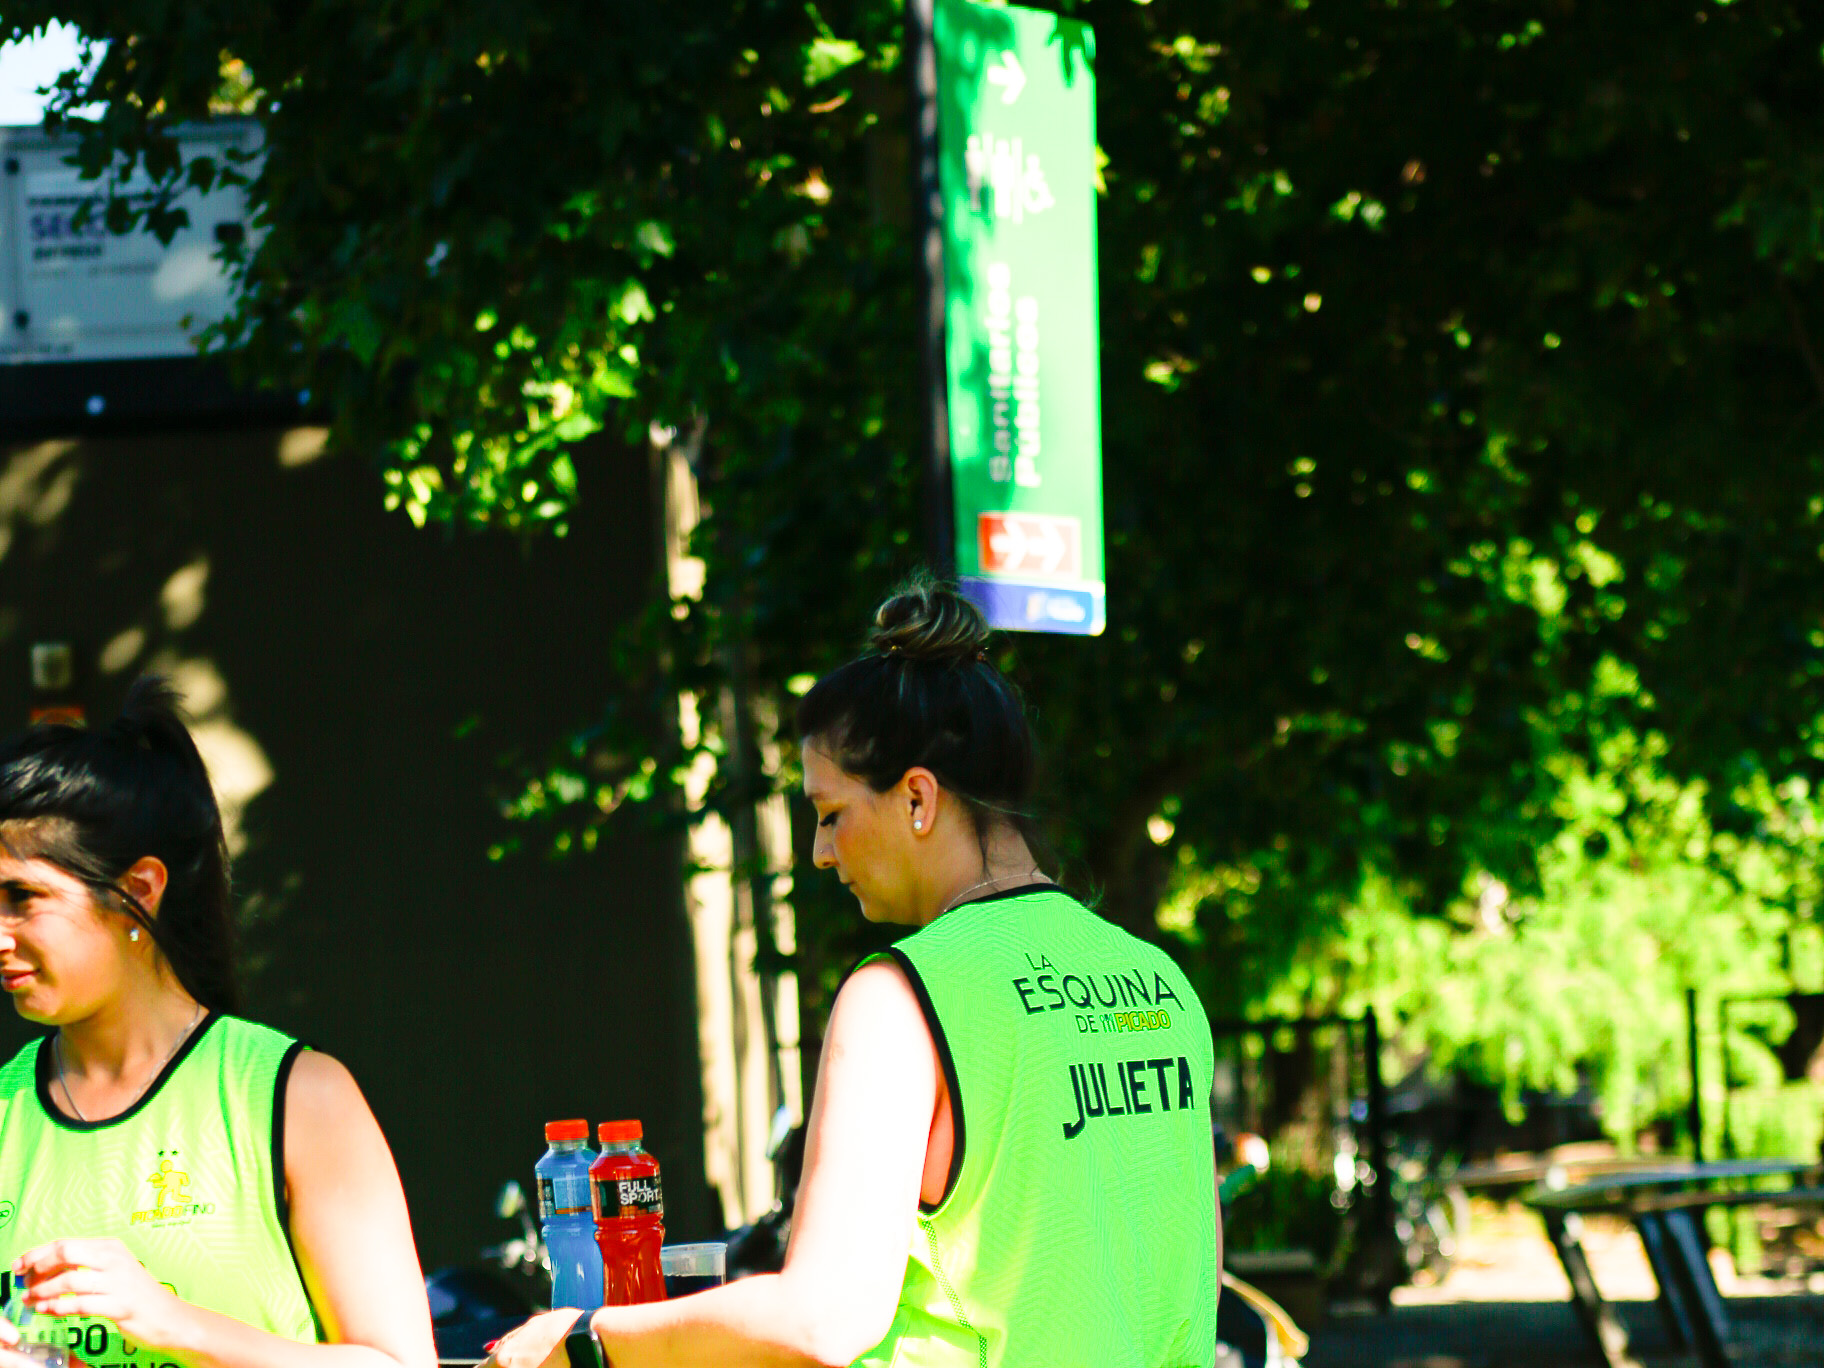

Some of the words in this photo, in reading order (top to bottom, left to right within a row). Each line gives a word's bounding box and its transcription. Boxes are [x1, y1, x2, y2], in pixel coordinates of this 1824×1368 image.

[985, 263, 1013, 483] Sanitarios
[1025, 952, 1060, 976] LA
[1012, 968, 1185, 1015] ESQUINA
[1075, 1014, 1098, 1034] DE
[1062, 1056, 1195, 1140] JULIETA
[619, 1180, 651, 1194] FULL
[620, 1188, 659, 1205] SPORT
